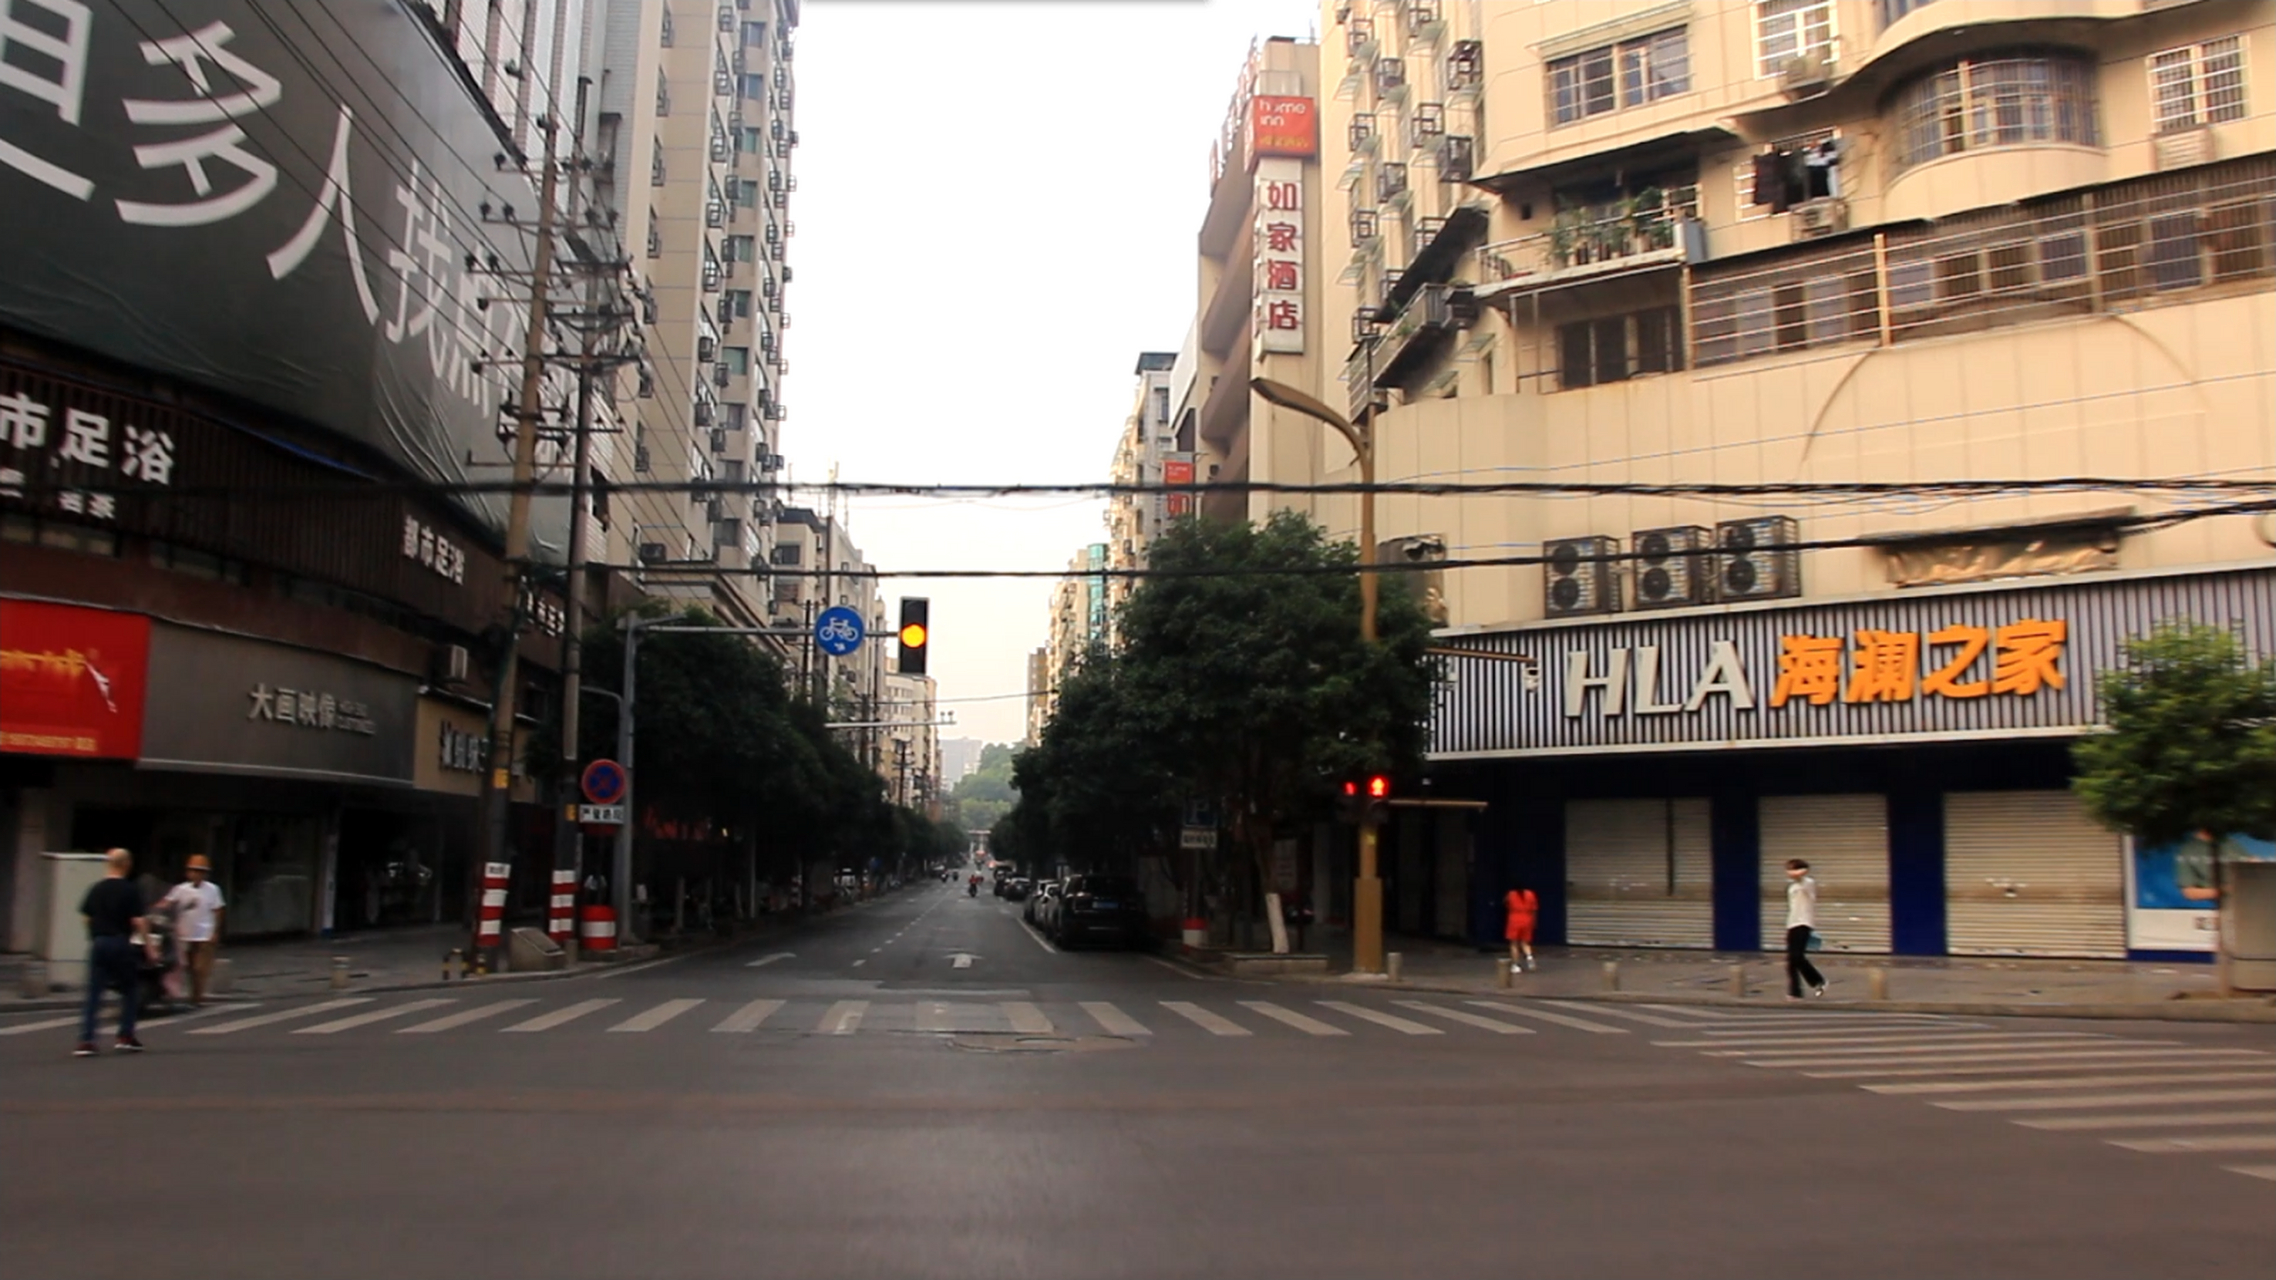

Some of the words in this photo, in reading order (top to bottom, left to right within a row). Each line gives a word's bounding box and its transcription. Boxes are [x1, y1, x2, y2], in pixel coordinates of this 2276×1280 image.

[1266, 181, 1298, 331] 如家酒店
[1564, 640, 1756, 719] HLA
[1767, 618, 2068, 710] 海澜之家
